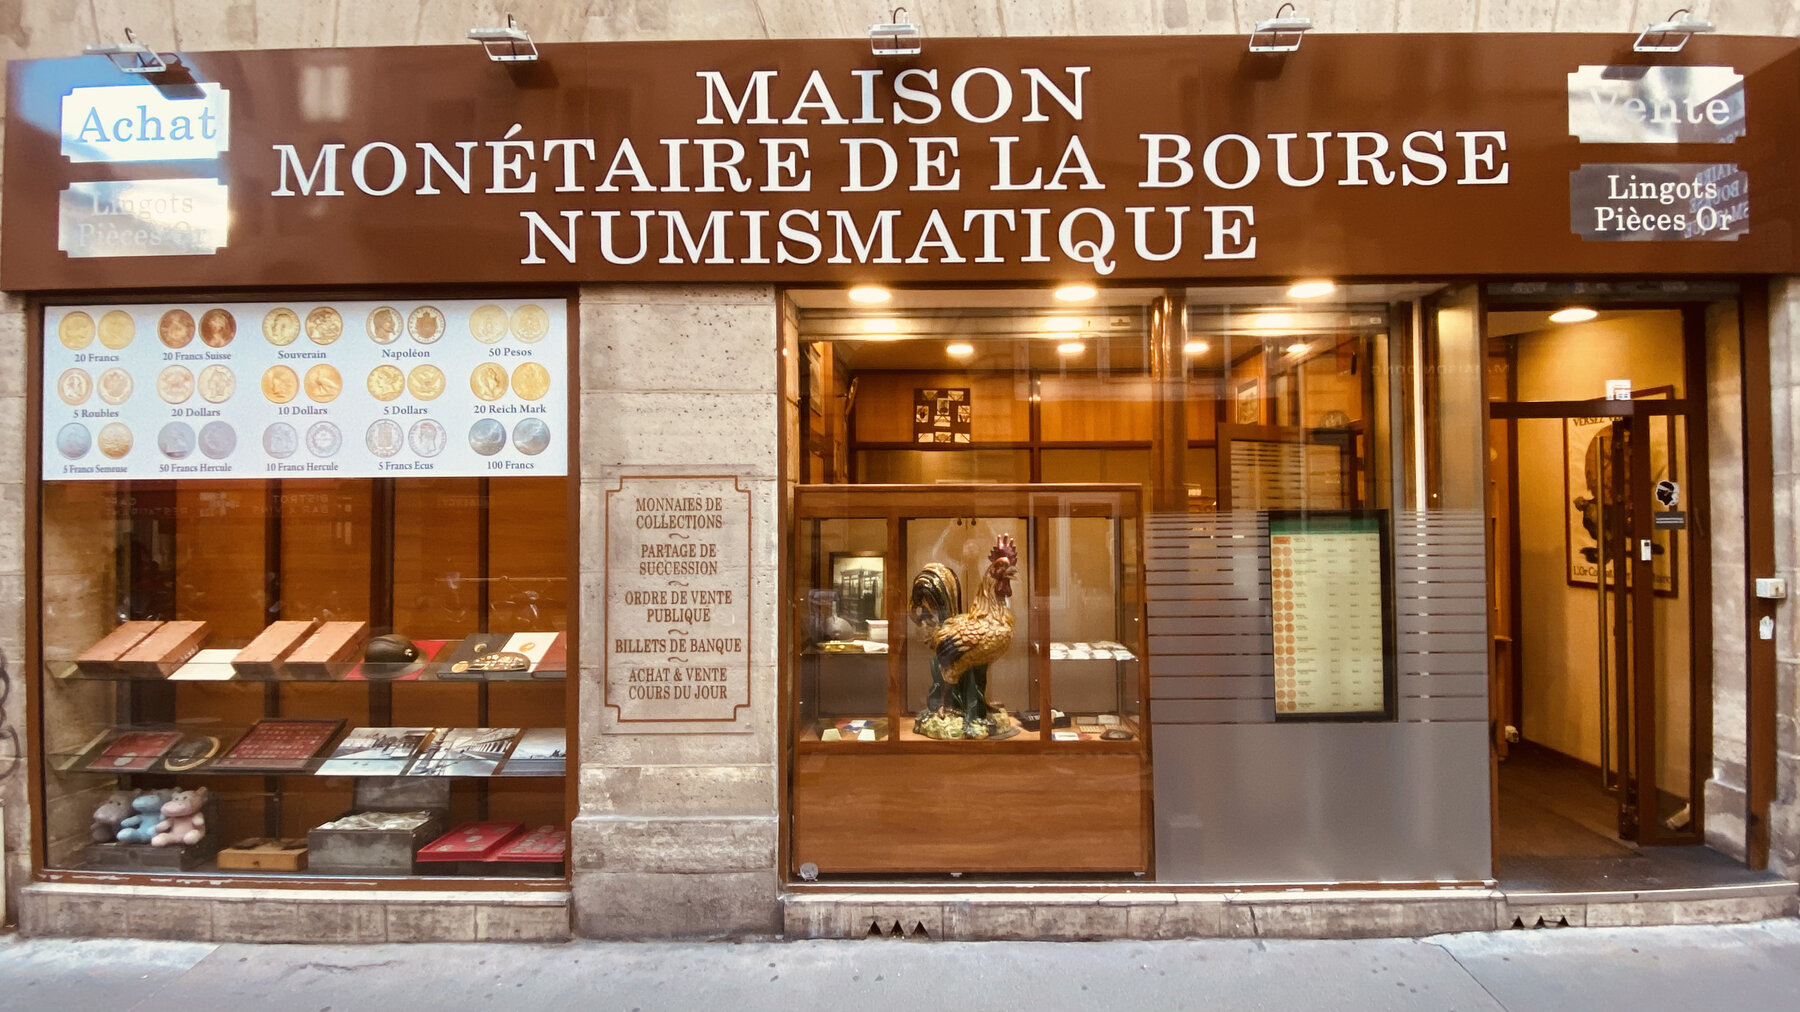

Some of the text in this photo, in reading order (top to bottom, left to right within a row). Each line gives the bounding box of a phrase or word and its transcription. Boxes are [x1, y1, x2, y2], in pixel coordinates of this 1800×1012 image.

[695, 66, 1092, 126] MAISON
[1589, 87, 1730, 125] Vente
[76, 104, 217, 143] Achat
[270, 122, 1511, 197] MONÉTAIRE DE LA BOURSE
[1607, 174, 1718, 205] Lingots
[91, 190, 194, 220] Lingots
[1594, 206, 1686, 232] Pièces
[1695, 206, 1732, 232] Or
[78, 220, 162, 247] Pièces
[519, 204, 1258, 276] NUMISMATIQUE
[74, 353, 119, 362] 20 Francs
[162, 351, 231, 361] 20 Francs Suisse
[277, 350, 327, 359] Souverain
[382, 348, 430, 359] Napoléon
[488, 347, 532, 357] 50 Pesos
[73, 408, 119, 418] 5 Roubles
[171, 407, 221, 417] 20 Dollars
[278, 406, 328, 415] 10 Dollars
[383, 405, 428, 415] 5 Dollars
[474, 404, 547, 414] 20 Reich Mark
[62, 465, 128, 473] 5 Francs Semeuse
[159, 463, 232, 472] 50 Francs Hercule
[266, 462, 339, 472] 10 Francs Hercule
[378, 461, 434, 470] 5 Francs Ecus
[487, 460, 535, 470] 100 Francs
[635, 497, 723, 512] MONNAIES DE
[636, 514, 723, 530] COLLECTIONS
[641, 543, 717, 558] PARTAGE DE
[639, 561, 718, 576] SUCCESSION
[624, 590, 733, 605] ORDRE DE VENTE
[646, 608, 711, 625] PUBLIQUE
[615, 638, 742, 655] BILLETS DE BANQUE
[628, 667, 728, 683] ACHAT & VENTE
[628, 685, 728, 700] COURS DU JOUR
